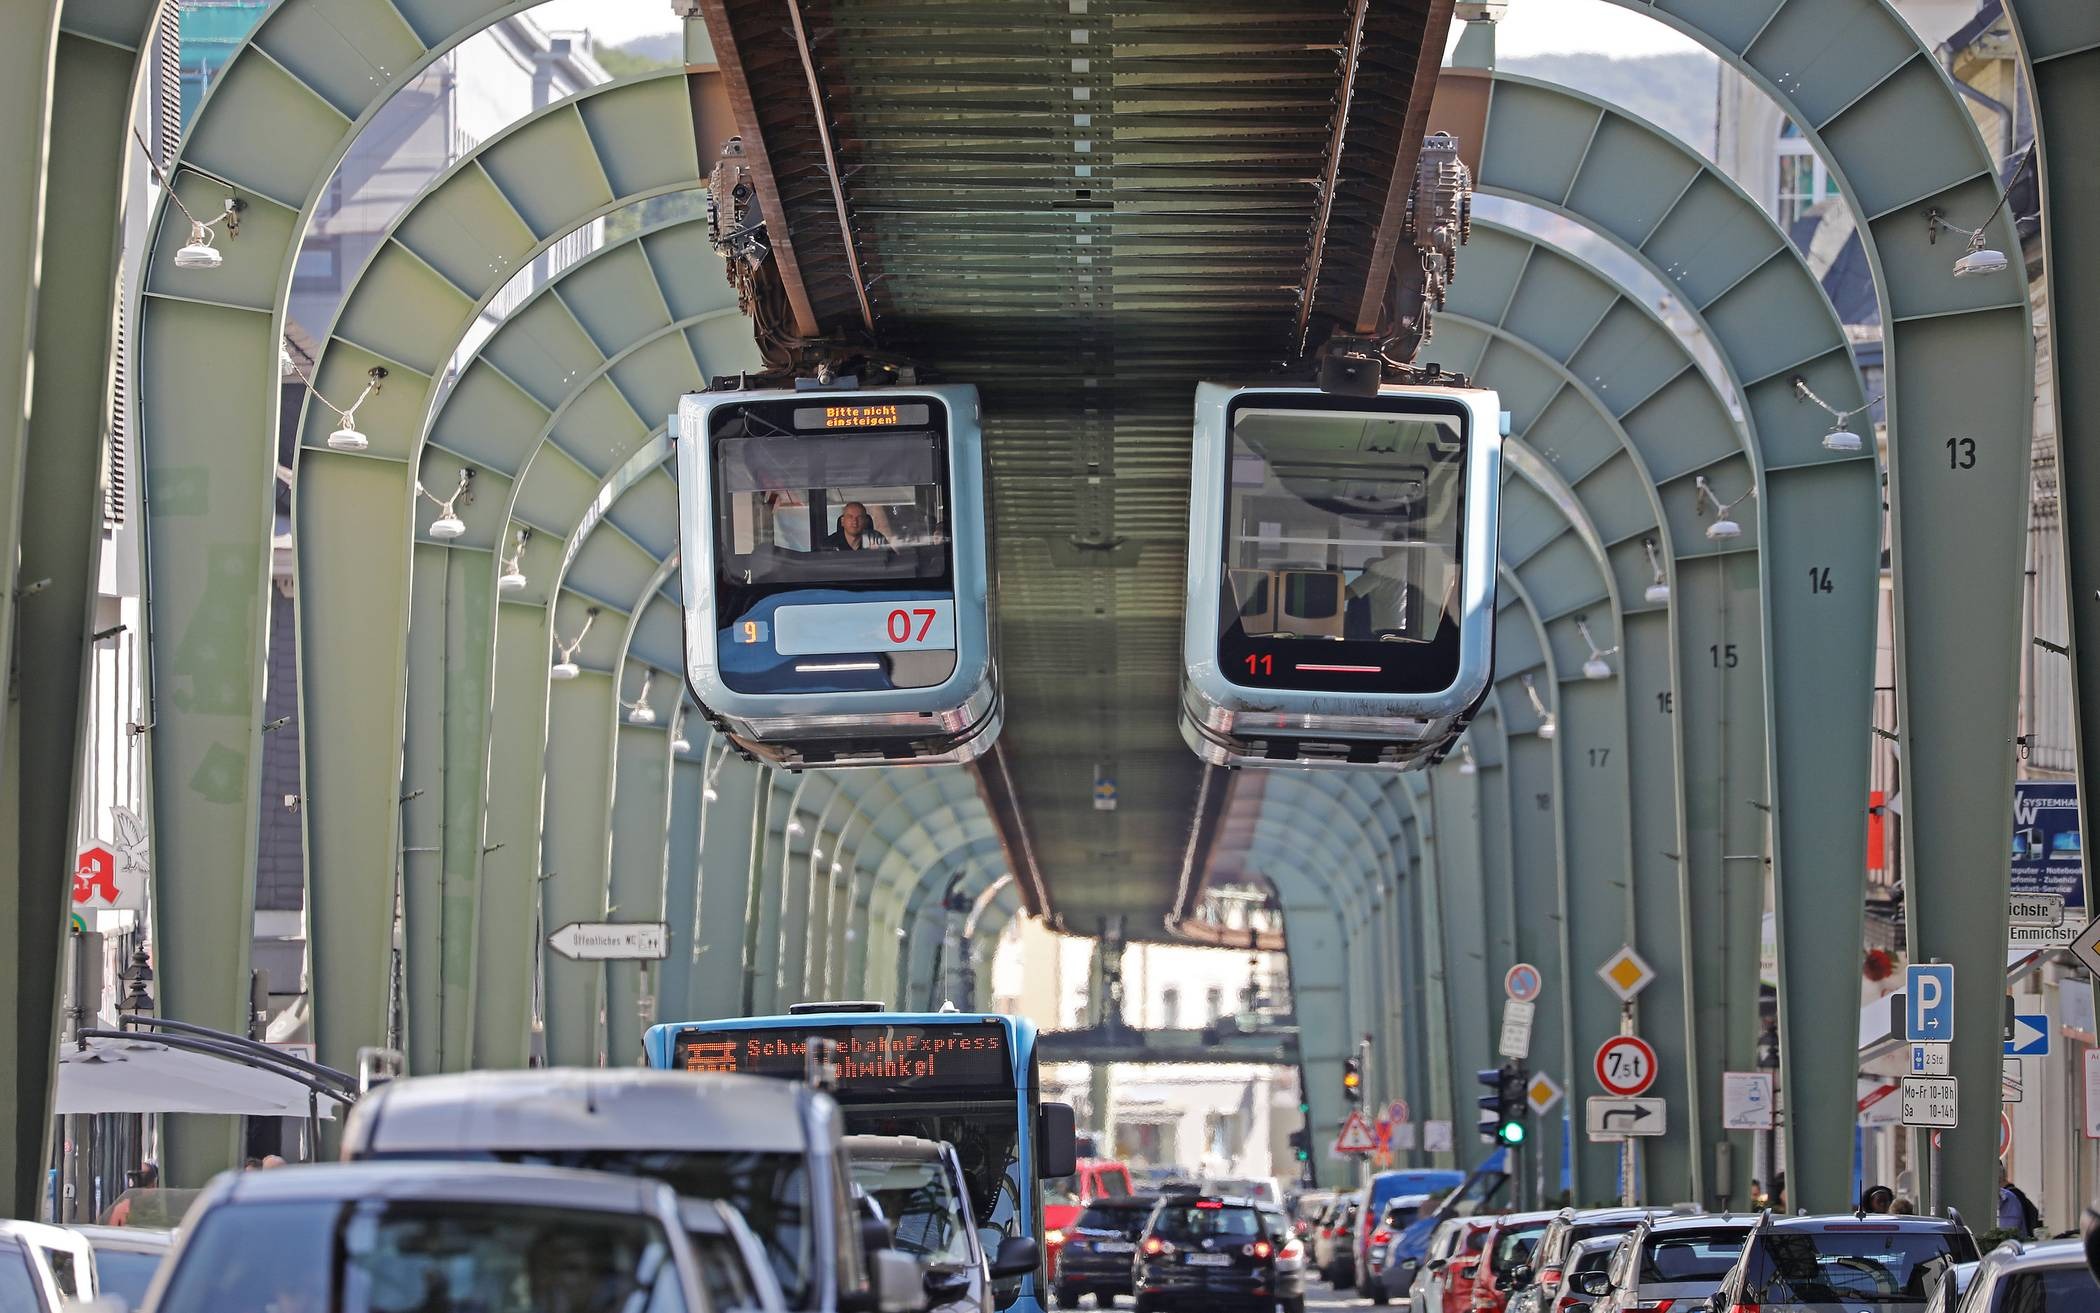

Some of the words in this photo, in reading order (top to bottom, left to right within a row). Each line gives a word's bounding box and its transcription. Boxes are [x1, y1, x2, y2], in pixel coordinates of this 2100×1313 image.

[826, 407, 859, 417] Bitte
[863, 405, 896, 416] nicht
[826, 415, 897, 427] einsteigen!
[1946, 437, 1976, 469] 13
[1809, 567, 1834, 594] 14
[743, 621, 757, 643] 9
[887, 608, 937, 643] 07
[1244, 654, 1272, 675] 11
[1710, 644, 1738, 668] 15
[1588, 748, 1610, 767] 17
[2010, 876, 2037, 884] efonie
[2011, 867, 2038, 875] mputer
[2009, 903, 2049, 917] ichstr.
[1917, 975, 1942, 1032] P
[747, 1034, 999, 1056] SchwebahnExpress
[814, 1053, 934, 1078] ohwinkel
[1926, 1054, 1931, 1065] 2
[1904, 1085, 1927, 1099] Mo-Fr
[1904, 1103, 1914, 1117] Sa
